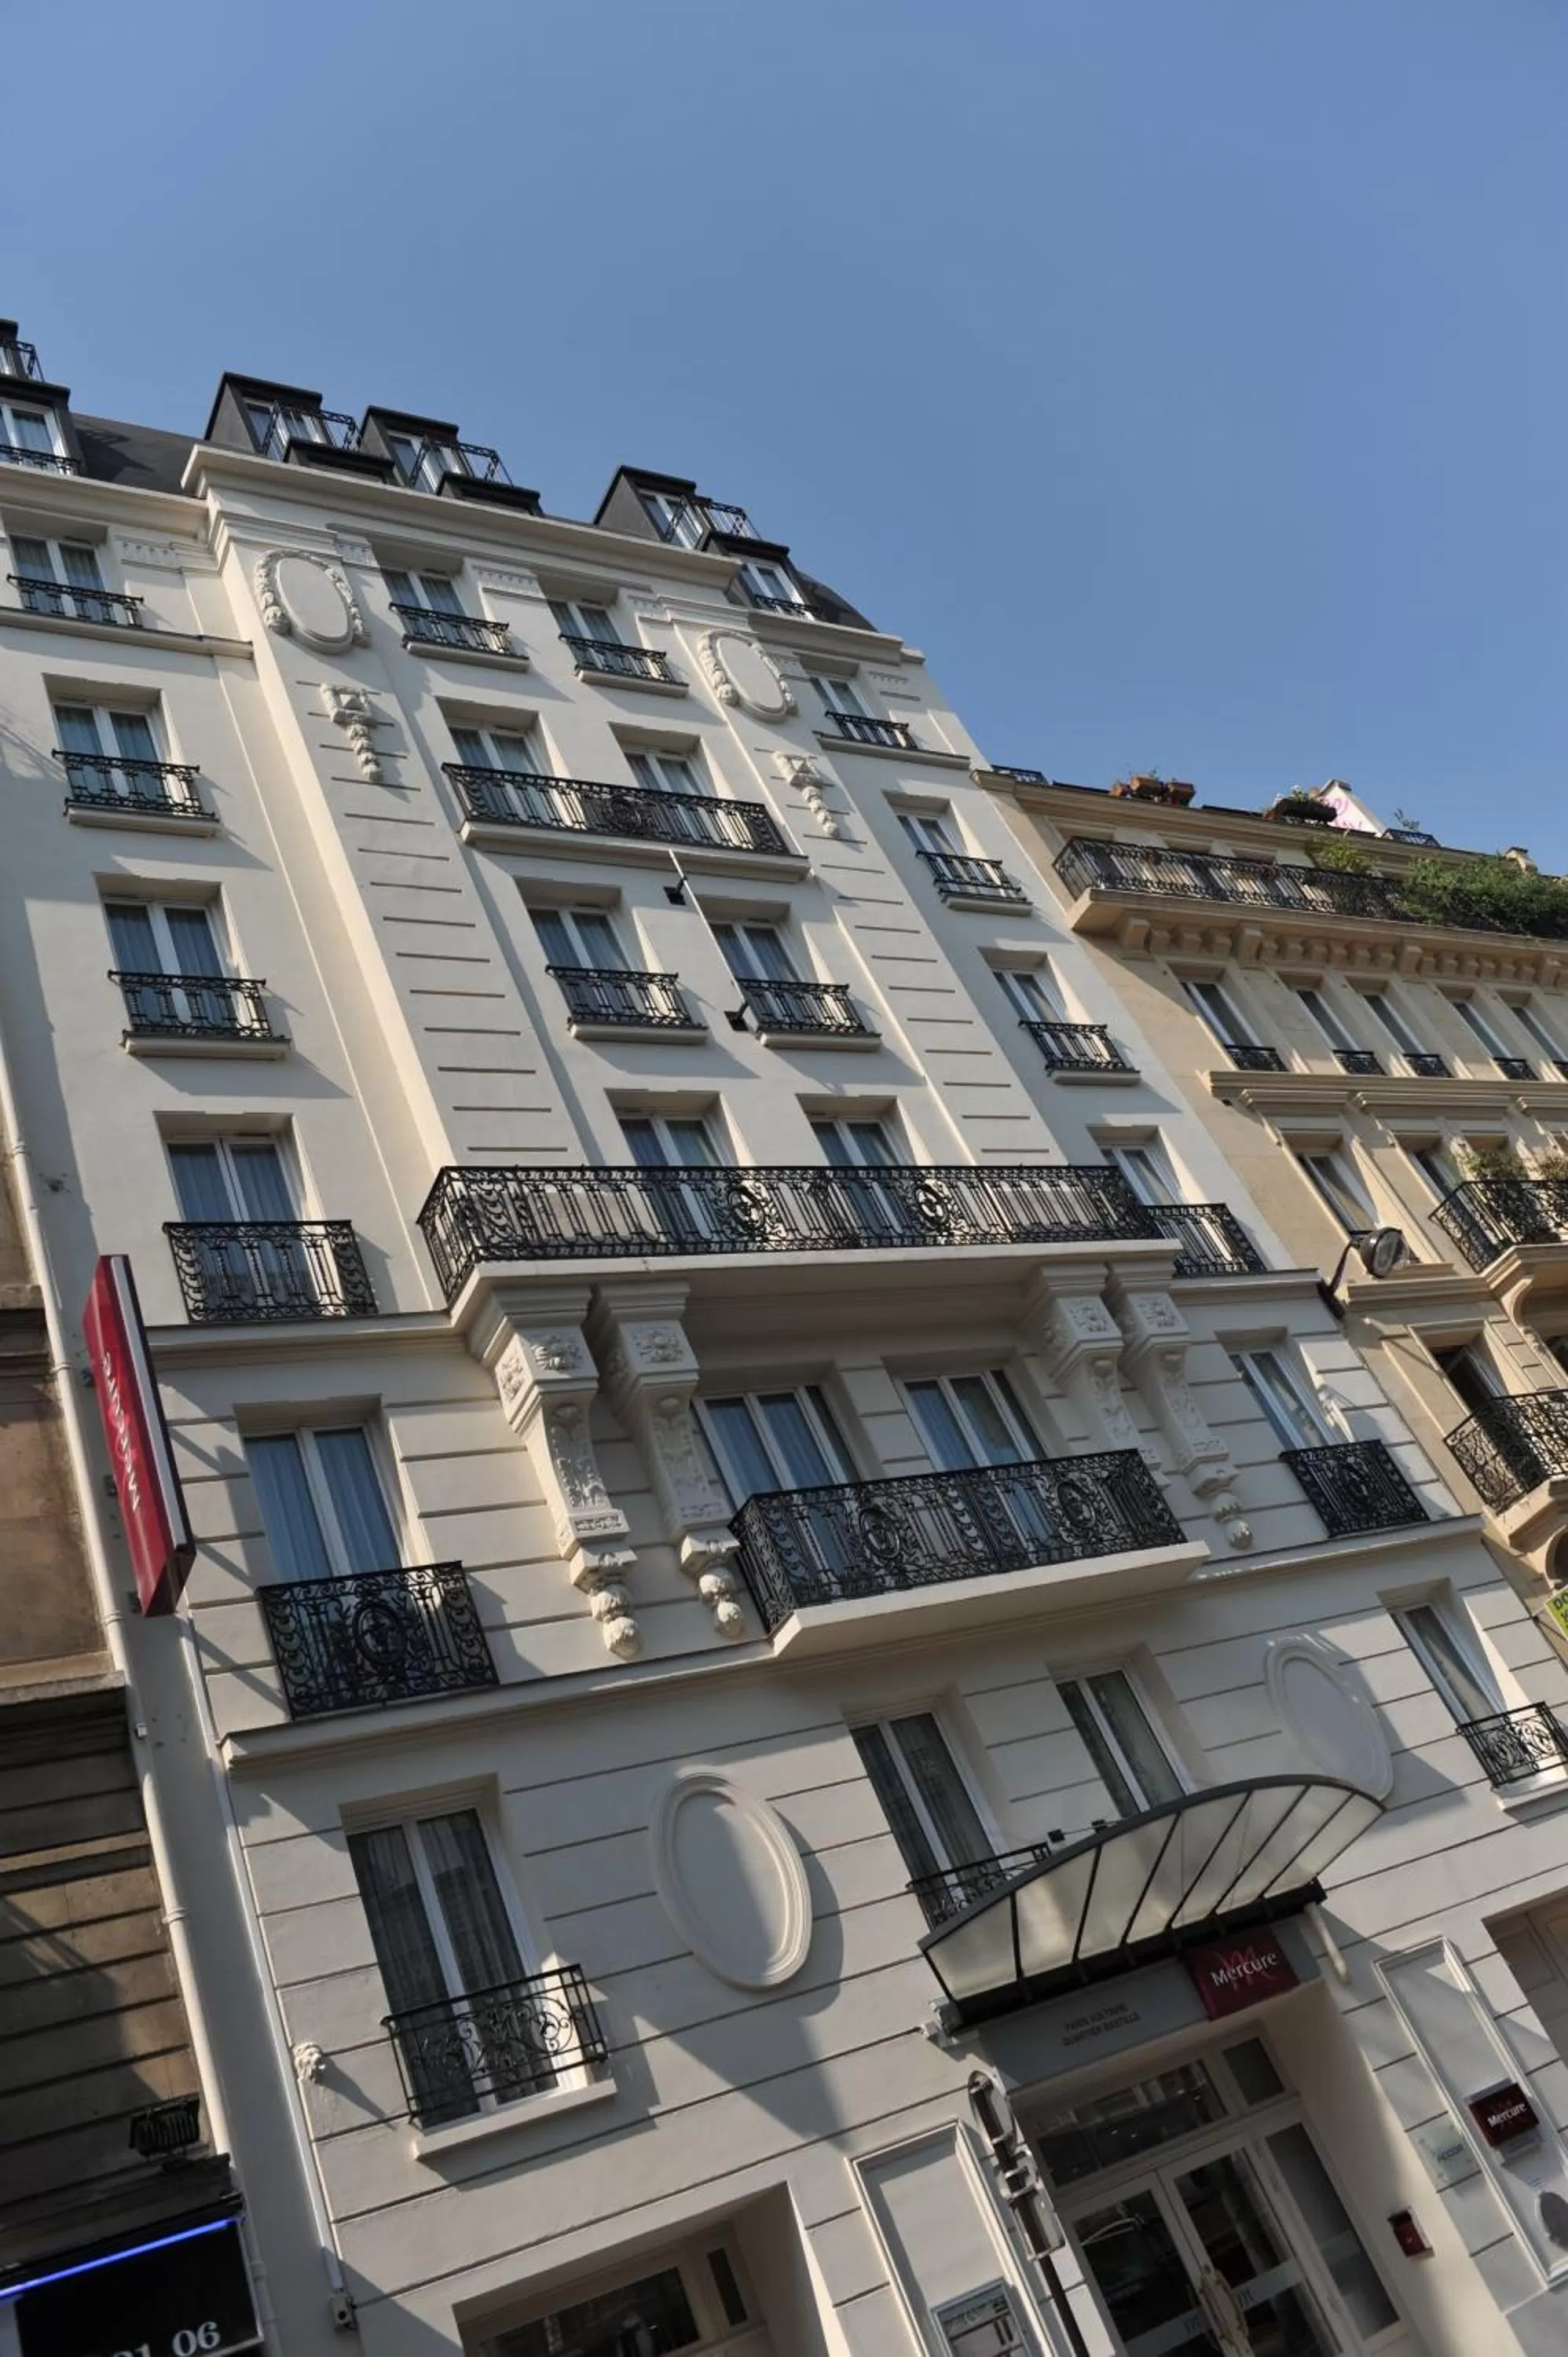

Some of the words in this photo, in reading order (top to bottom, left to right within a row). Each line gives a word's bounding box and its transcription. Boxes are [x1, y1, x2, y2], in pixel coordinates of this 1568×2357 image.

[1211, 1952, 1277, 1986] Mercure
[1487, 2102, 1528, 2128] Mercure
[172, 2321, 221, 2357] 06
